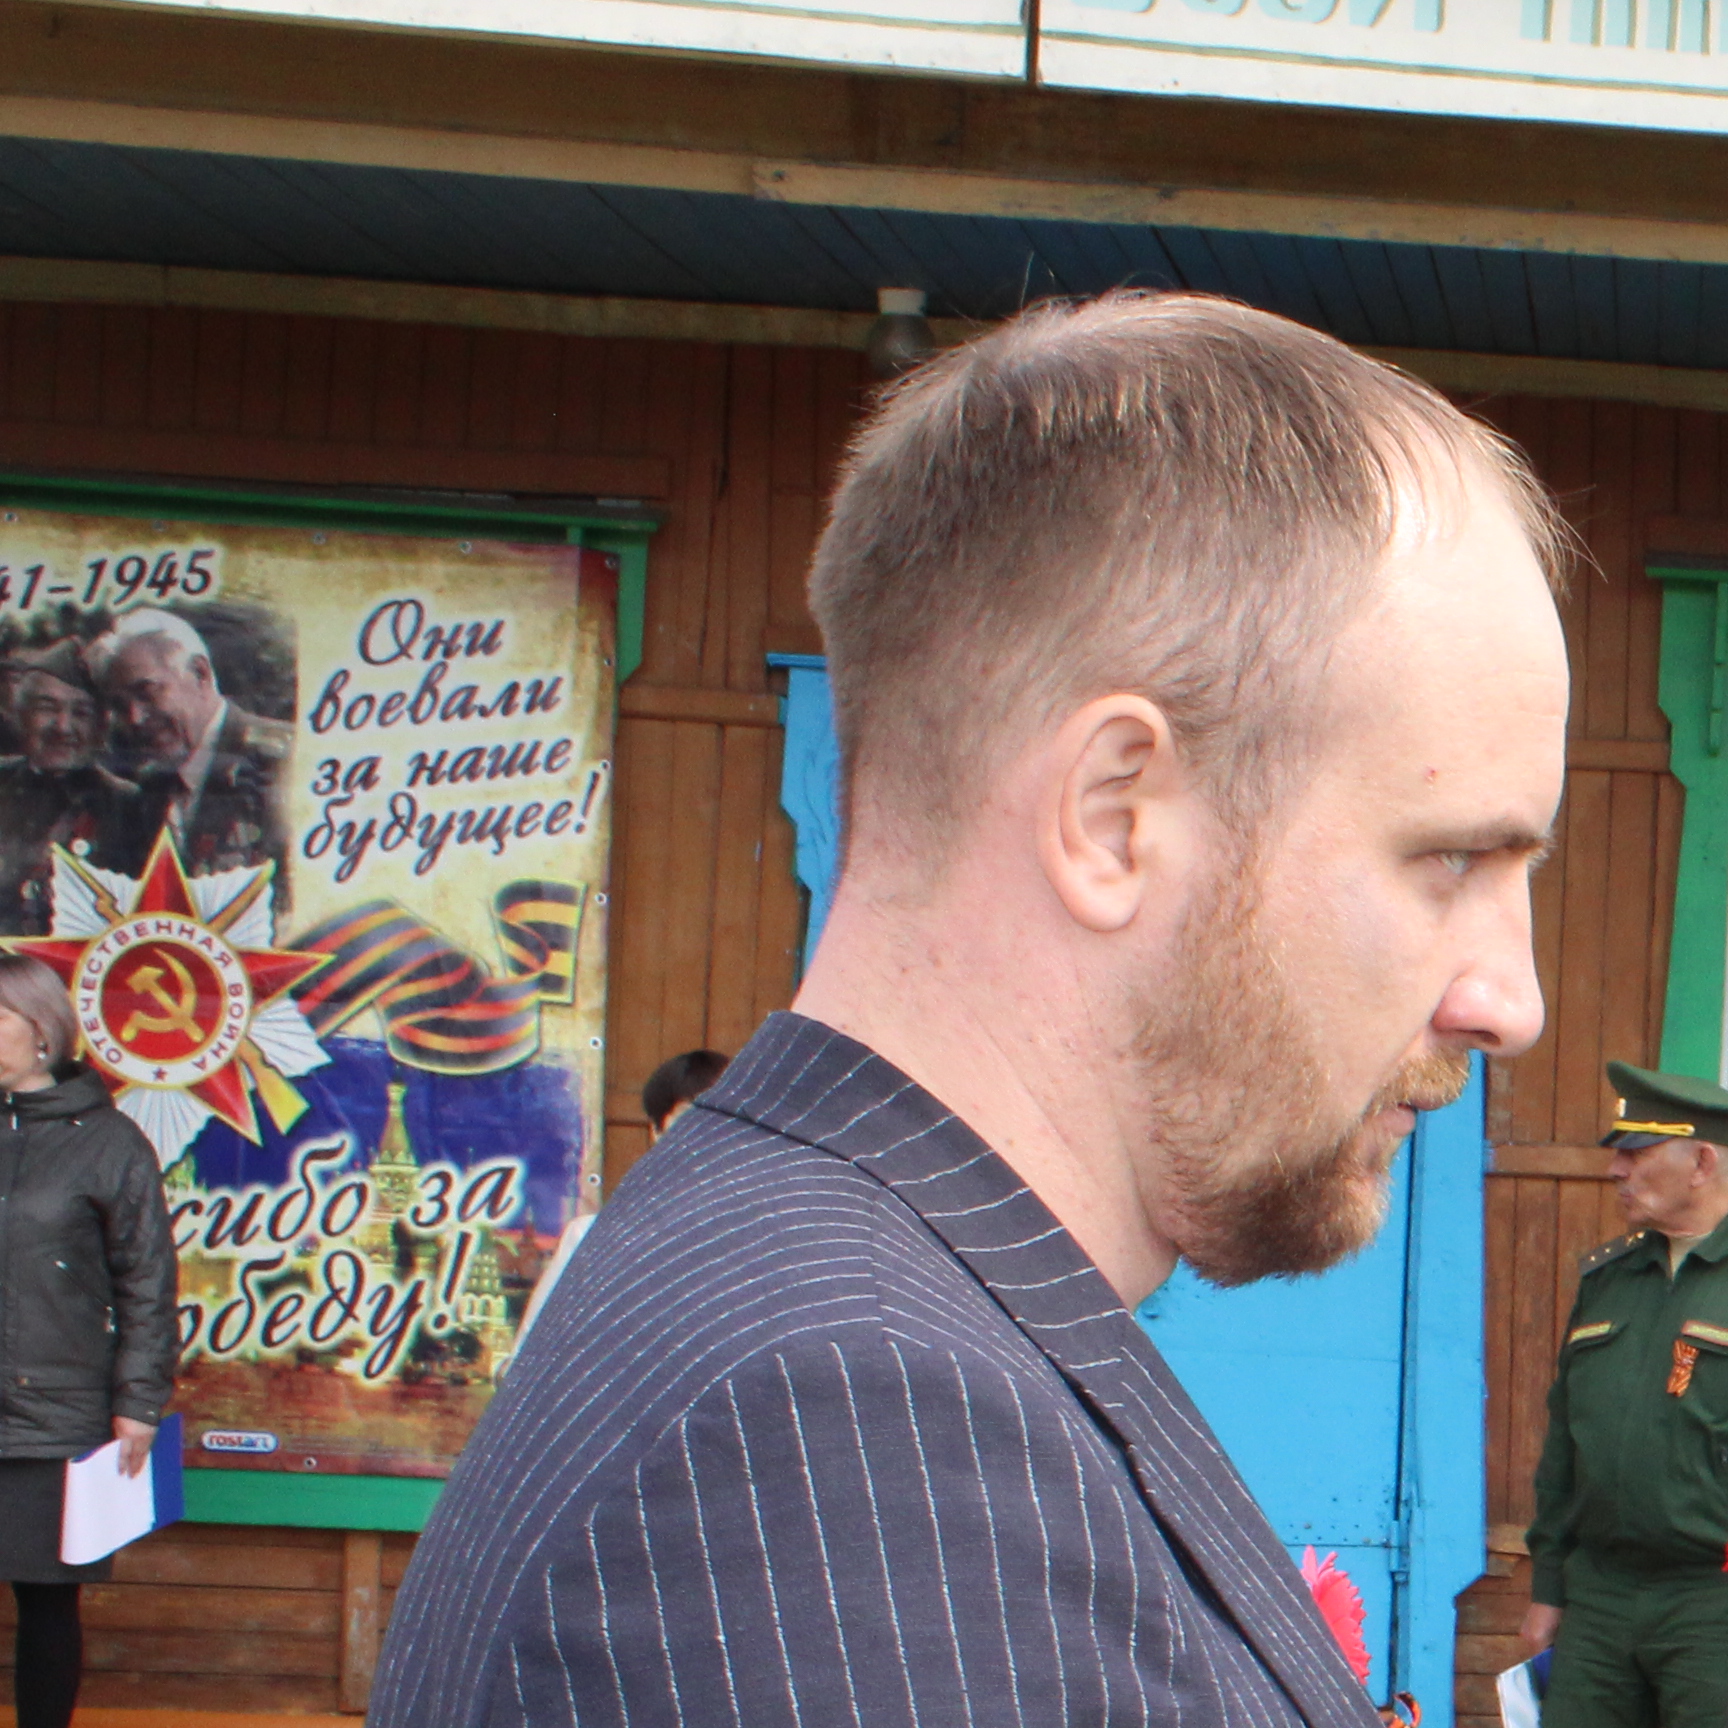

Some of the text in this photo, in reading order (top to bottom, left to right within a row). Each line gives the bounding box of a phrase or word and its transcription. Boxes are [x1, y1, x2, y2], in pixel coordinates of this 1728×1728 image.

[358, 598, 505, 666] Они
[308, 662, 563, 735] воевали
[309, 737, 573, 797] за наше
[302, 771, 600, 883] будущее!
[81, 920, 234, 1065] ОТЕЧЕСТВЕННАЯ
[170, 1139, 517, 1250] сибо за
[176, 1230, 474, 1380] обеду!
